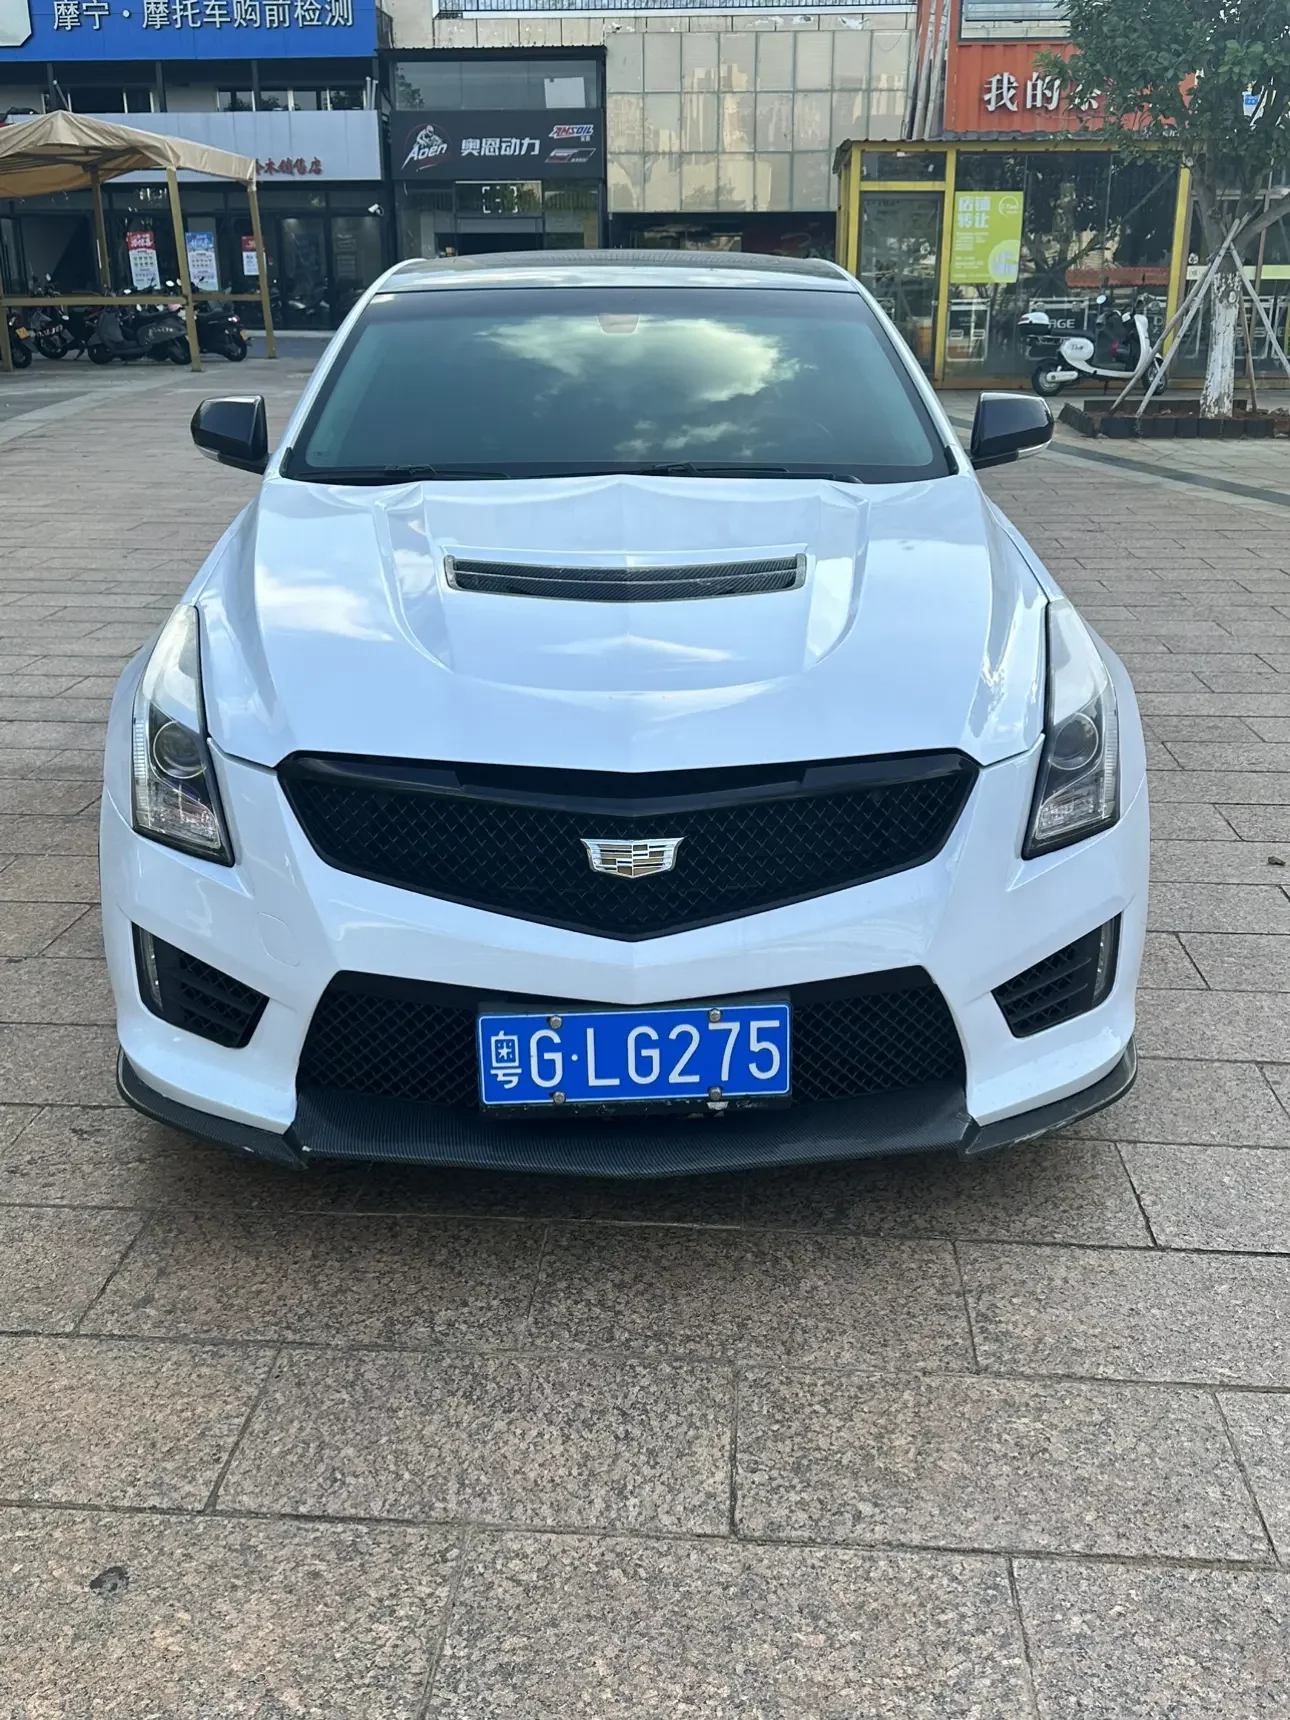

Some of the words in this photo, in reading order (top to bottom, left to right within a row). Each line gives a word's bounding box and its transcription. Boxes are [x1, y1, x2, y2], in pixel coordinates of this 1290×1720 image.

[549, 124, 594, 139] AMSOIL
[461, 138, 540, 156] 奥恩动力
[490, 1020, 781, 1090] 粤G·LG275
